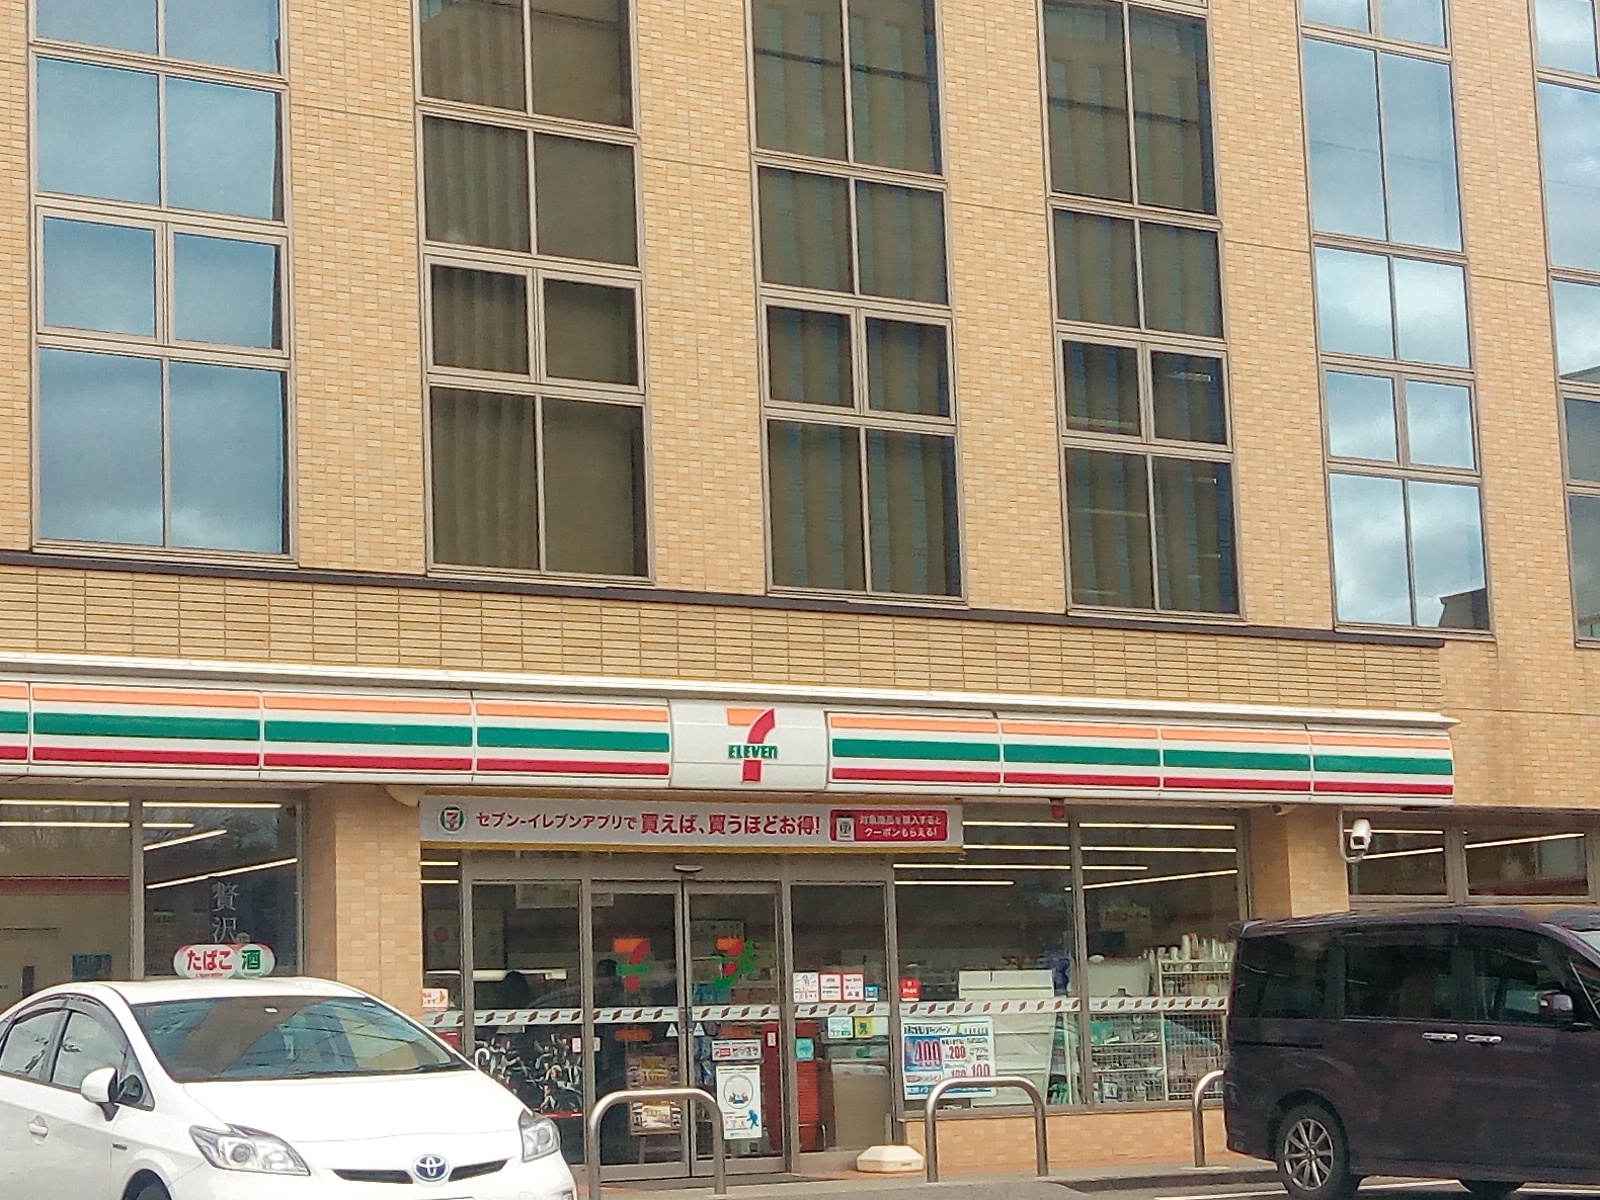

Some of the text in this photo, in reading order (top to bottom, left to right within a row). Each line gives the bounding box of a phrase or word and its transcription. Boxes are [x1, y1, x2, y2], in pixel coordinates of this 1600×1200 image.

[726, 707, 776, 783] 7
[186, 949, 261, 971] たばこ 酒
[948, 1045, 967, 1060] 200
